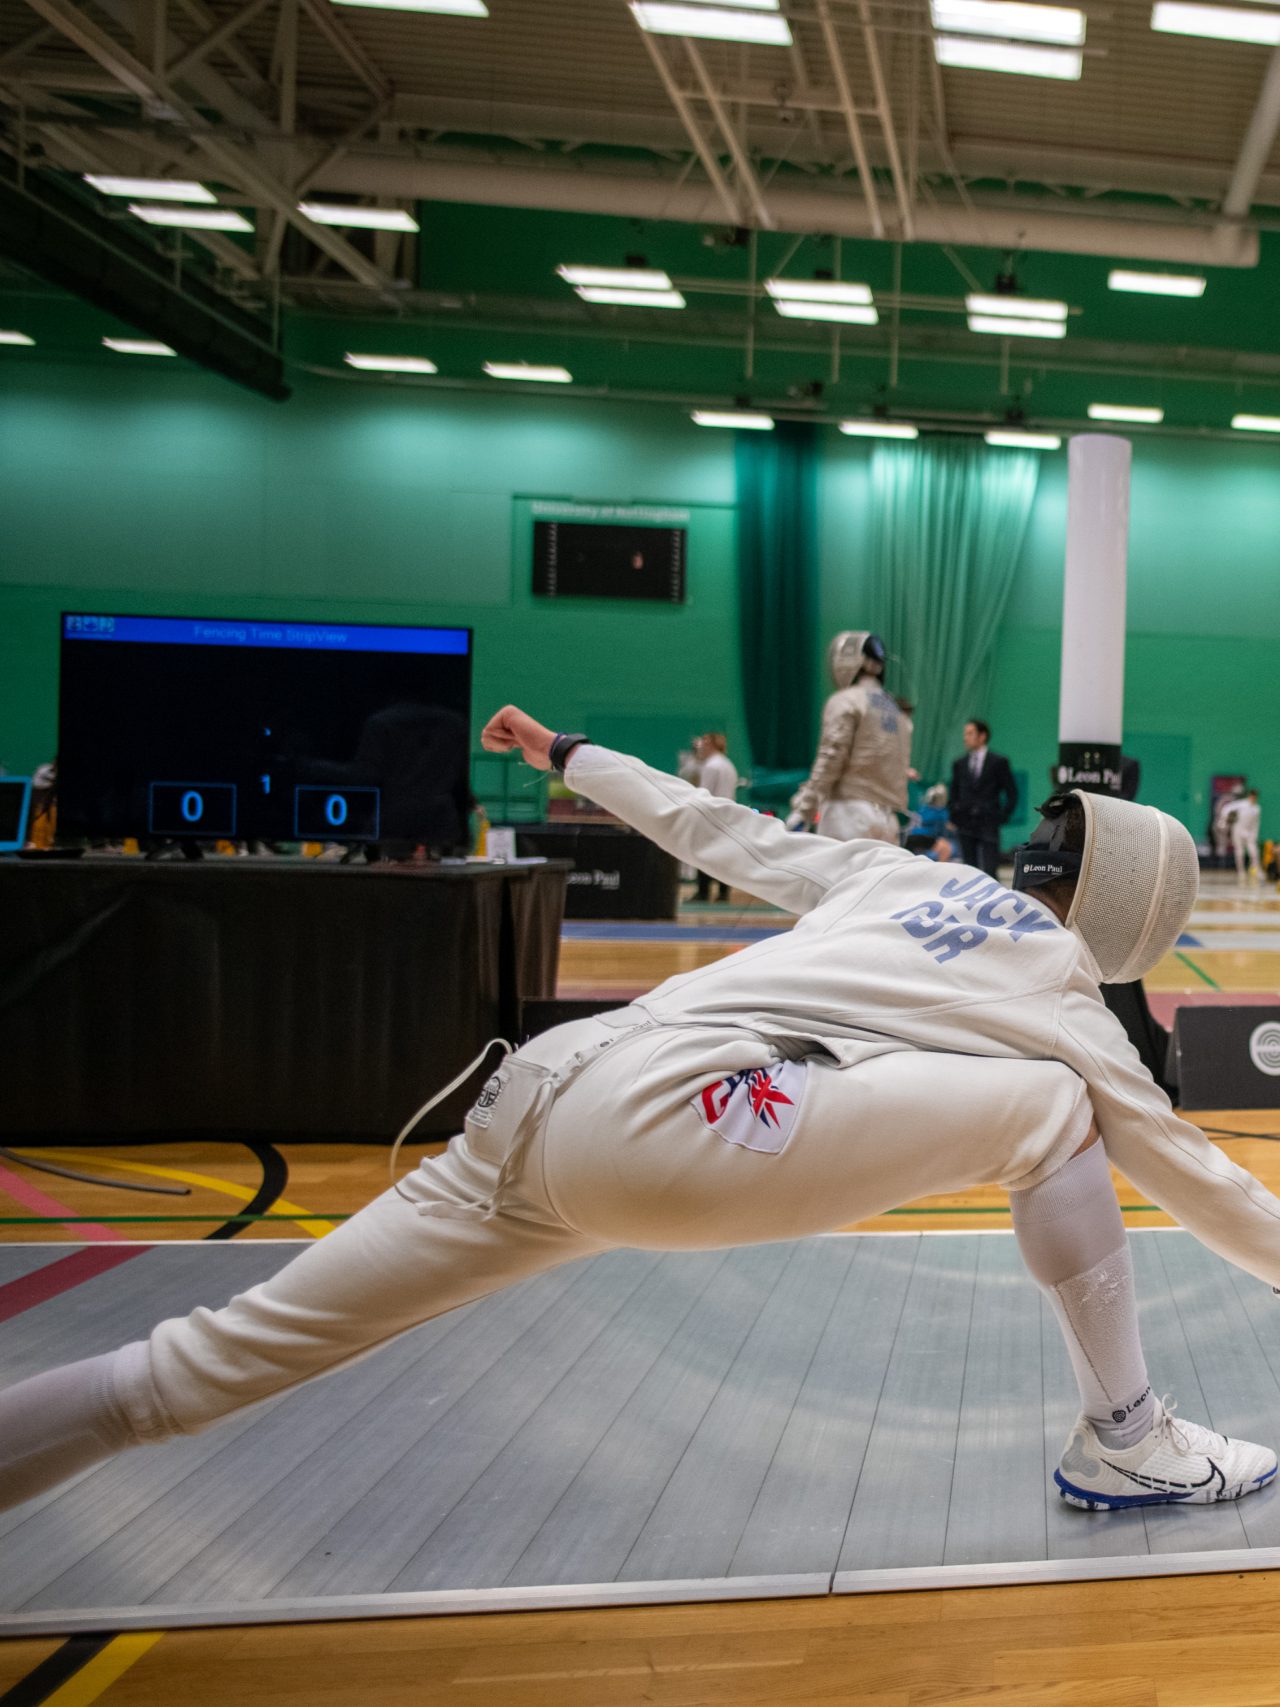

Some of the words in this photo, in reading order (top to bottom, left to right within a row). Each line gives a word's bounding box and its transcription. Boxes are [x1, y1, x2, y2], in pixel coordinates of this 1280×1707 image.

[193, 626, 247, 643] Fencing
[251, 628, 283, 641] Time
[286, 629, 347, 645] StripView
[260, 774, 271, 794] 1
[1067, 766, 1101, 783] Leon
[181, 790, 204, 822] 0
[325, 794, 347, 826] 0
[1029, 864, 1046, 873] Leon
[1047, 864, 1063, 873] Paul
[938, 873, 1058, 943] JACK
